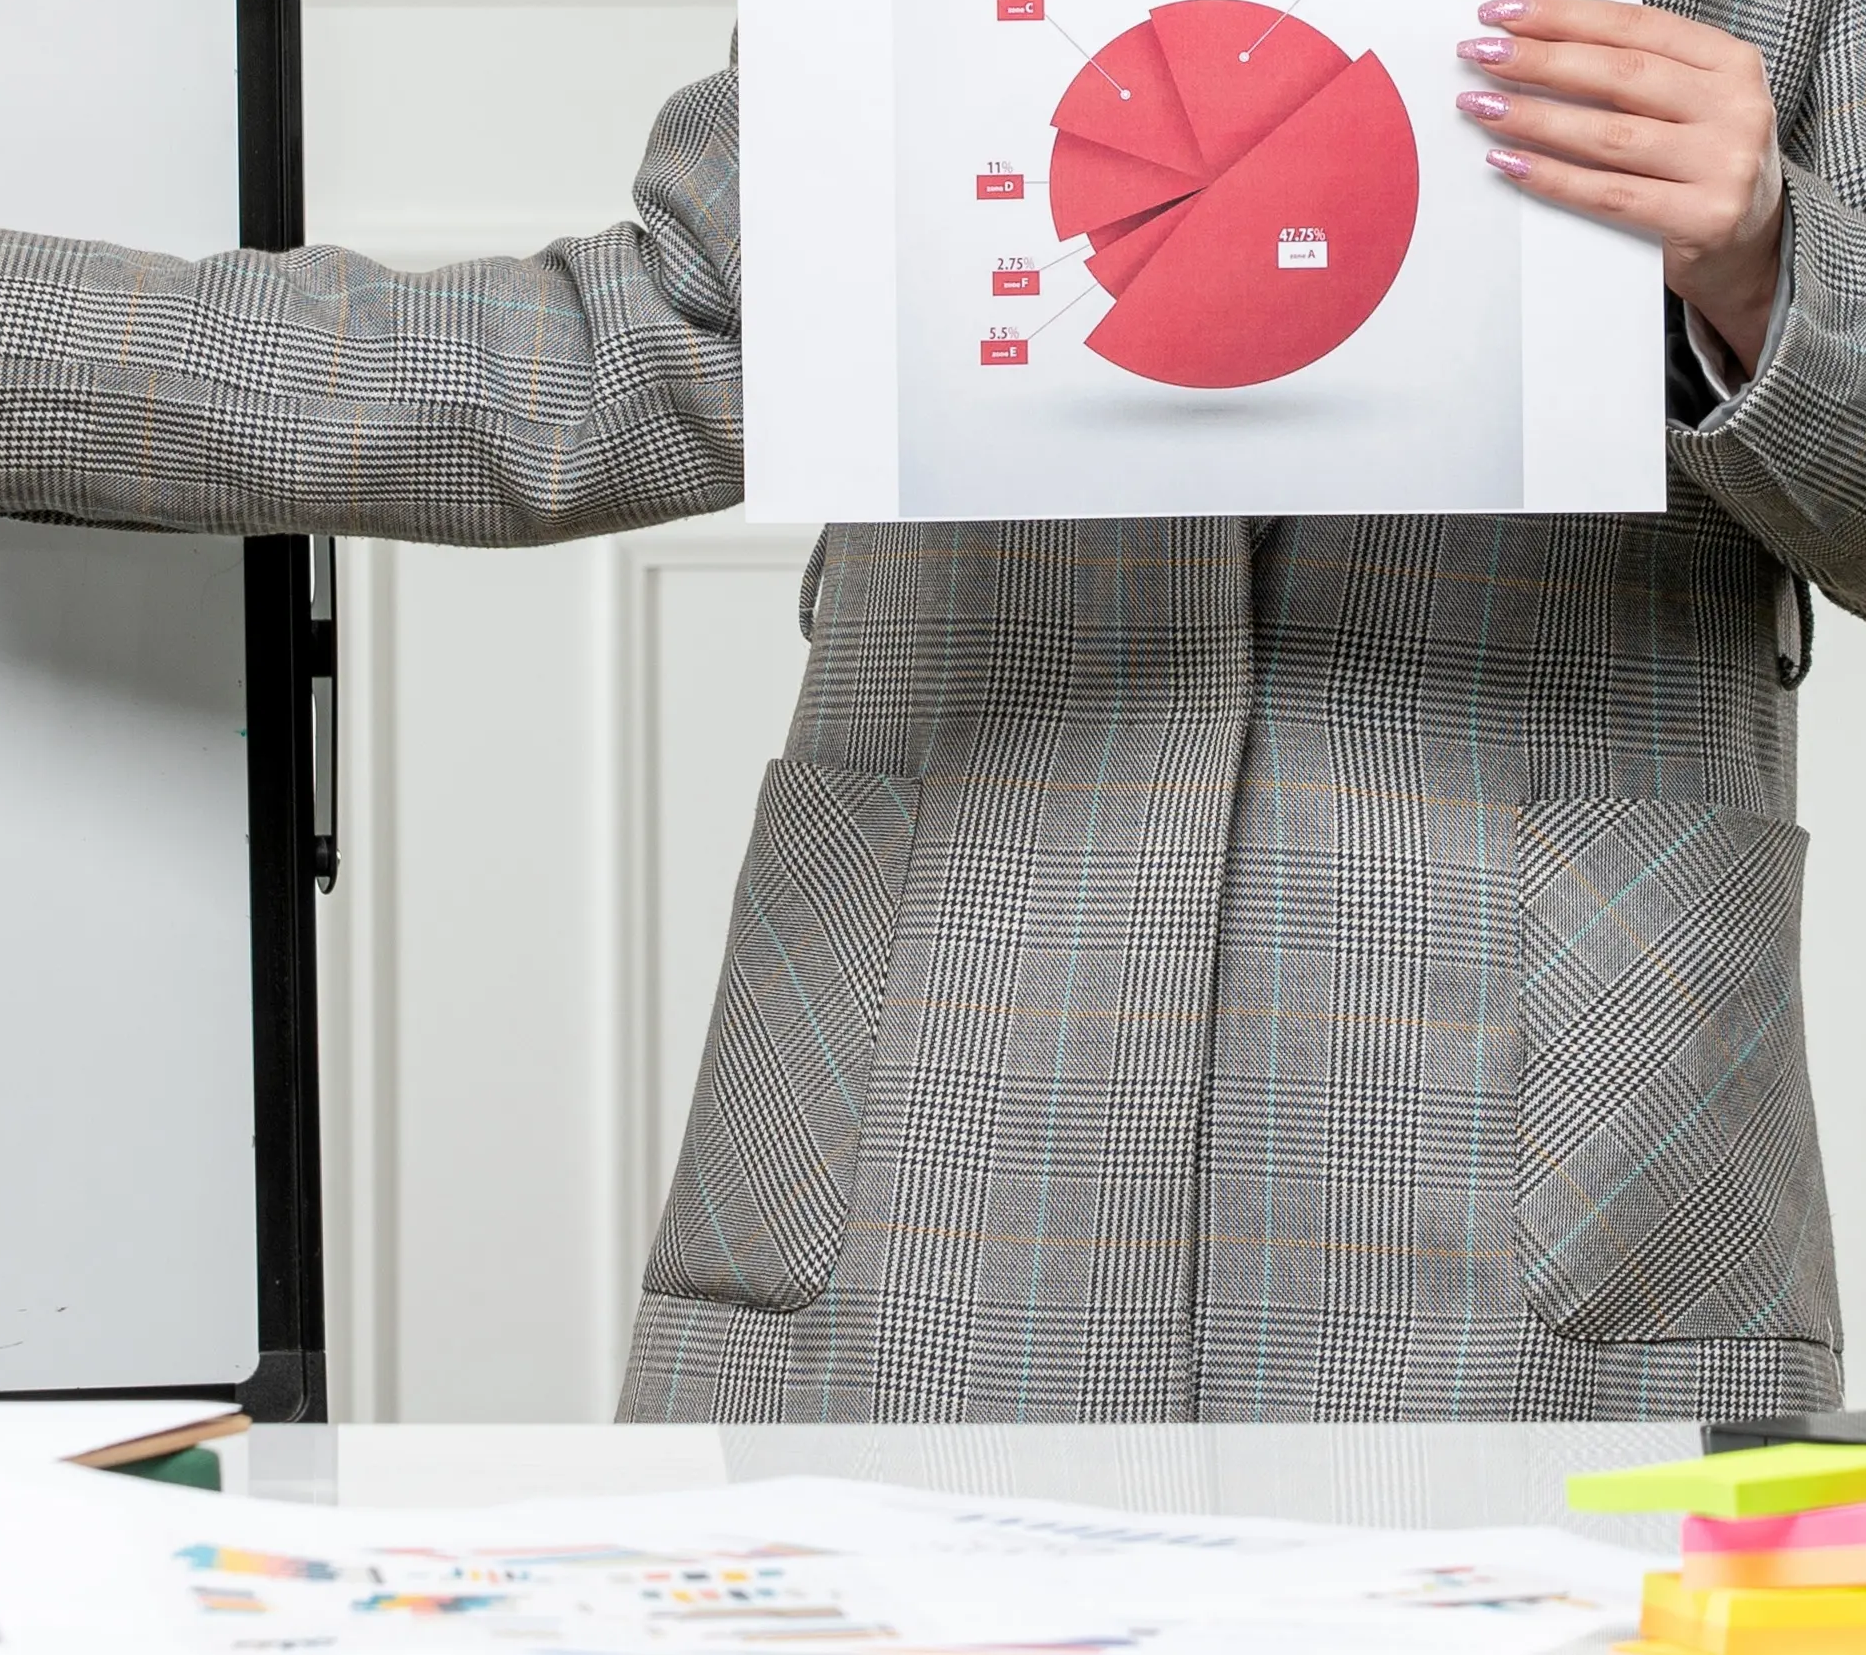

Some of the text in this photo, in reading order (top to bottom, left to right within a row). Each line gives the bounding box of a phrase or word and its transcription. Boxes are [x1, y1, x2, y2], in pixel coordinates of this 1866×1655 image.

[1025, 2, 1033, 13] C
[987, 161, 1012, 173] 11%
[1005, 182, 1013, 191] D
[1279, 228, 1325, 241] 47.75%
[1308, 250, 1315, 258] A
[997, 258, 1034, 270] 2.75%
[1022, 278, 1028, 288] F
[989, 327, 1019, 339] 5.5%
[1010, 347, 1017, 357] E
